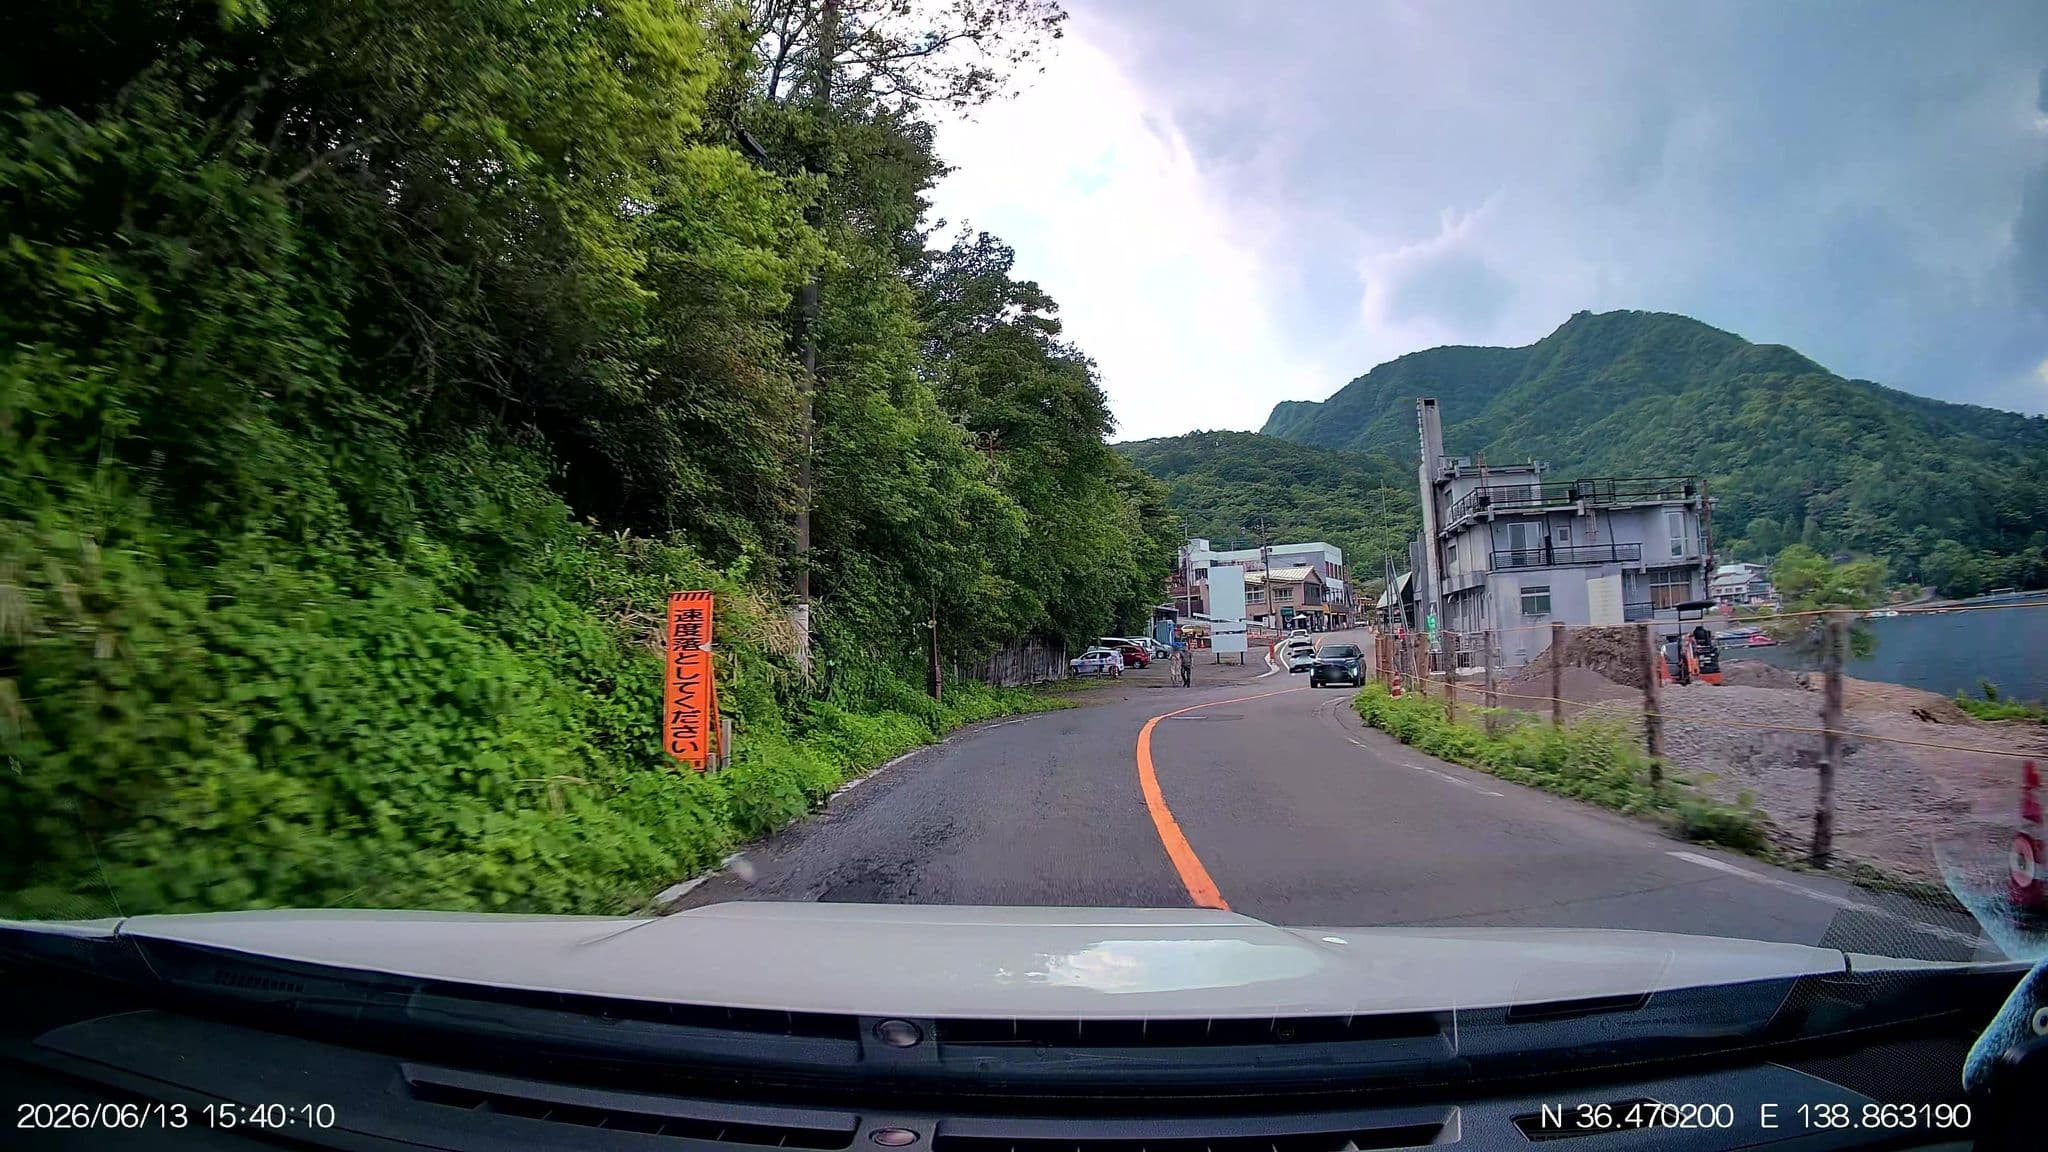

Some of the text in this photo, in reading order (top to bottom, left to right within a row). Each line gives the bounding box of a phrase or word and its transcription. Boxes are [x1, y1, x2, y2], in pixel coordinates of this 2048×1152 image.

[672, 608, 704, 754] 速度落としてください
